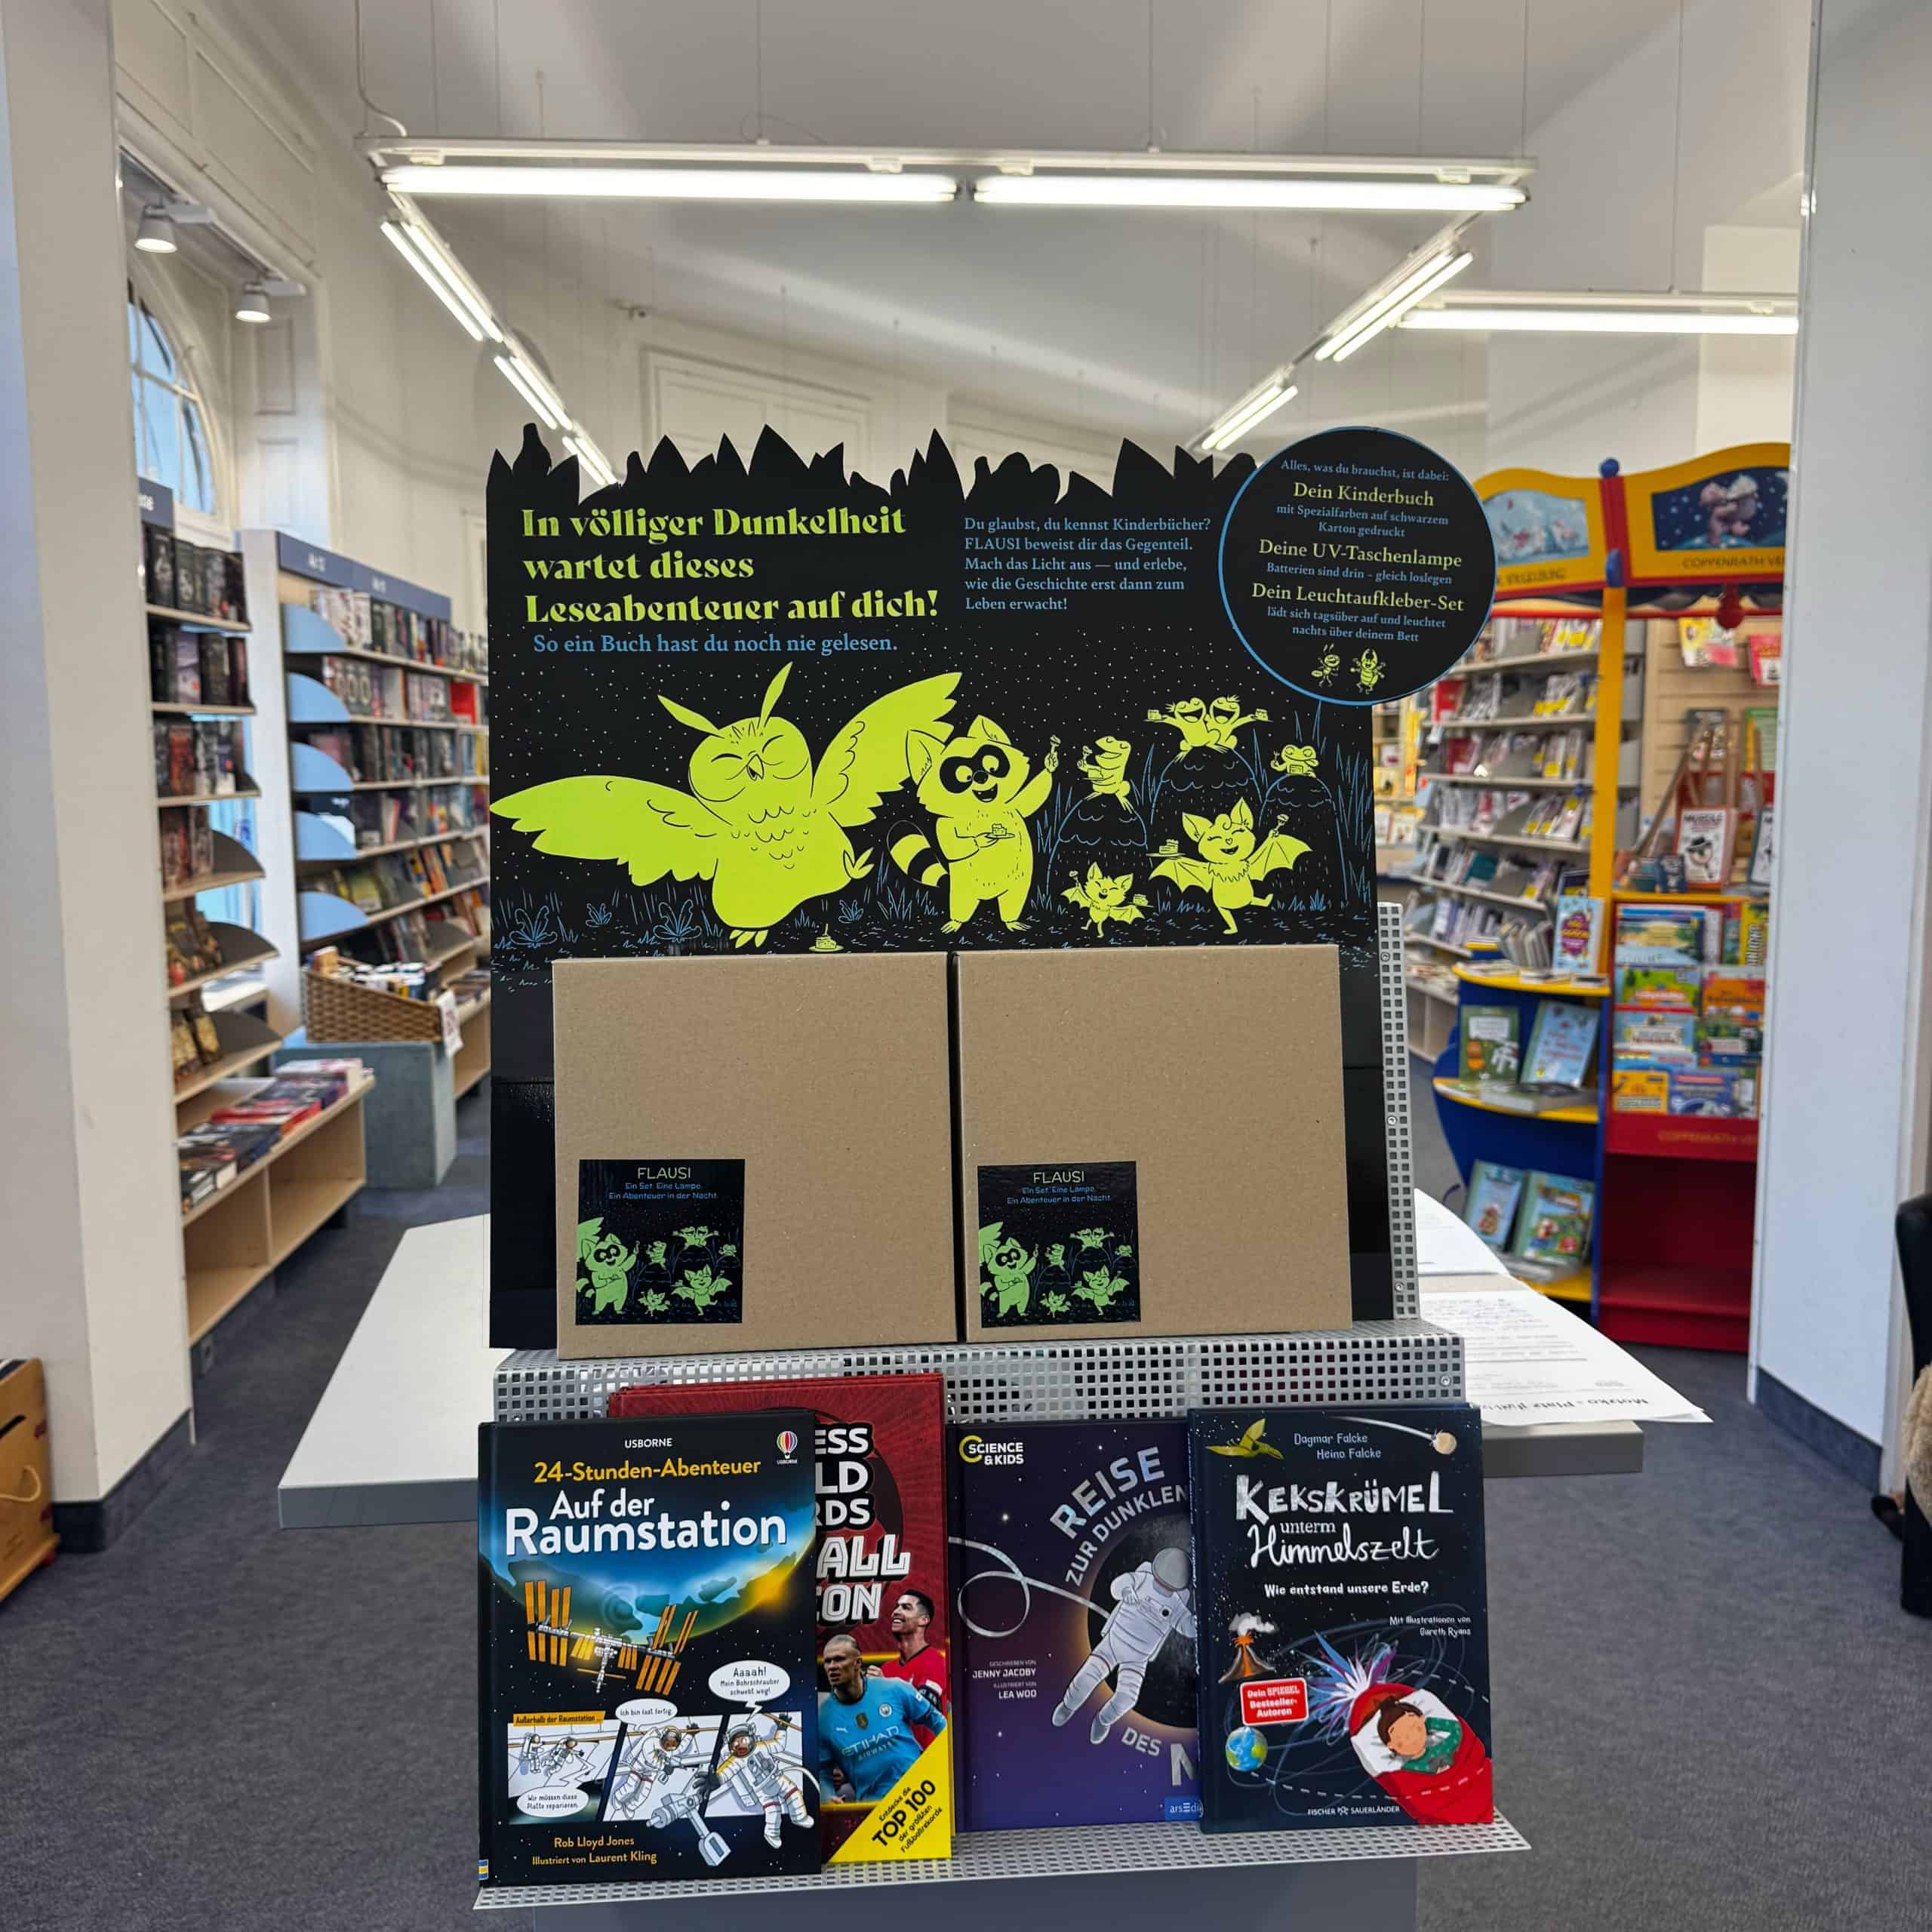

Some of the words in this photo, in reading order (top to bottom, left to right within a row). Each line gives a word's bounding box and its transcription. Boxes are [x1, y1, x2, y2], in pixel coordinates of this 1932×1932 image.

[1281, 460, 1311, 472] Alles,
[1314, 463, 1334, 473] was
[1336, 463, 1349, 474] du
[1352, 464, 1399, 478] brauchst,
[1402, 468, 1416, 478] ist
[1418, 469, 1449, 481] dabei:
[1294, 481, 1333, 500] Dein
[1338, 485, 1434, 506] Kinderbuch
[1276, 504, 1294, 515] mit
[1297, 505, 1369, 521] Spezialfarben
[1371, 510, 1389, 521] auf
[1390, 511, 1449, 525] schwarzem
[521, 509, 560, 537] In
[570, 508, 703, 544] völliger
[712, 506, 906, 536] Dunkelheit
[964, 518, 984, 530] Du
[988, 518, 1040, 533] glaubst,
[1044, 518, 1060, 530] du
[1064, 518, 1109, 531] kennst
[1112, 518, 1211, 531] Kinderbücher?
[1318, 521, 1356, 534] Karton
[1358, 525, 1405, 538] gedruckt
[965, 538, 1020, 550] FLAUSI
[1025, 538, 1075, 550] beweist
[1078, 538, 1097, 550] dir
[1100, 538, 1122, 550] das
[1125, 538, 1192, 553] Gegenteil.
[1259, 538, 1308, 557] Deine
[1312, 542, 1462, 571] UV-Taschenlampe
[522, 553, 641, 580] wartet
[650, 550, 754, 579] dieses
[965, 558, 1003, 571] Mach
[1006, 558, 1028, 571] das
[1032, 558, 1066, 571] Licht
[1069, 561, 1091, 571] aus
[1115, 558, 1140, 571] und
[1143, 558, 1187, 572] erlebe,
[1267, 562, 1315, 576] Batterien
[1318, 565, 1339, 577] sind
[1342, 565, 1364, 578] drin
[1376, 568, 1407, 582] gleich
[1409, 571, 1452, 586] loslegen
[965, 578, 988, 590] wie
[992, 577, 1012, 590] die
[1015, 577, 1088, 590] Geschichte
[1091, 580, 1115, 590] erst
[1119, 578, 1152, 590] dann
[1155, 581, 1185, 590] zum
[965, 598, 1007, 611] Leben
[1010, 598, 1068, 611] erwacht!
[1251, 583, 1291, 600] Dein
[1296, 586, 1464, 611] Leuchtaufkleber-Set
[525, 594, 778, 623] Leseabenteuer
[787, 591, 846, 619] auf
[851, 589, 938, 618] dich!
[1267, 606, 1287, 618] lädt
[1290, 608, 1311, 620] sich
[1312, 610, 1358, 624] tagsüber
[1361, 611, 1377, 623] auf
[1380, 614, 1401, 625] und
[1403, 616, 1447, 628] leuchtet
[1292, 625, 1327, 636] nachts
[1329, 627, 1352, 638] über
[1355, 628, 1394, 640] deinem
[1397, 631, 1419, 641] Bett
[534, 635, 558, 653] So
[564, 634, 595, 653] ein
[601, 635, 652, 653] Buch
[657, 633, 698, 653] hast
[704, 633, 729, 653] du
[734, 633, 780, 652] noch
[787, 634, 817, 652] nie
[821, 635, 897, 656] gelesen.
[638, 1167, 691, 1180] FLAUSI
[1033, 1171, 1084, 1184] FLAUSI
[624, 1438, 672, 1449] USBORNE
[1294, 1433, 1333, 1446] Dagmar
[1337, 1432, 1368, 1444] Falcke
[968, 1442, 1023, 1454] SCIENCE
[1317, 1448, 1345, 1460] Heino
[1349, 1448, 1381, 1460] Falcke
[984, 1456, 993, 1466] &
[995, 1454, 1024, 1466] KIDS
[534, 1458, 761, 1484] 24-Stunden-Abenteuer
[1050, 1446, 1165, 1540] REISE
[1235, 1470, 1454, 1525] KEKSKRÜMEL
[549, 1488, 605, 1521] Auf
[610, 1487, 655, 1517] der
[506, 1500, 787, 1556] Raumstation
[1280, 1522, 1336, 1534] unterm
[1247, 1522, 1440, 1568] Himmelszelt
[1066, 1540, 1097, 1586] ZUR
[1264, 1583, 1286, 1598] Wie
[1290, 1583, 1343, 1595] entstand
[1347, 1584, 1388, 1595] unsere
[1392, 1580, 1429, 1595] Erde?
[816, 1583, 881, 1621] ON
[1389, 1616, 1404, 1626] Mit
[1405, 1616, 1455, 1624] Illustrationen
[972, 1669, 1001, 1678] JENNY
[1003, 1668, 1036, 1677] JACOBY
[998, 1690, 1014, 1700] LEA
[1016, 1689, 1037, 1699] WOO
[1247, 1689, 1266, 1698] Dein
[1249, 1697, 1297, 1709] Bestseller-
[1257, 1709, 1292, 1718] Autoren
[1121, 1727, 1162, 1757] DES
[872, 1809, 907, 1847] TOP
[906, 1780, 936, 1810] 100
[1308, 1807, 1335, 1816] FISCHER
[1351, 1805, 1400, 1814] SAUERLÄNDER
[554, 1837, 575, 1848] Rob
[577, 1835, 605, 1850] Lloyd
[606, 1835, 635, 1847] Jones
[532, 1855, 569, 1866] Illustriert
[589, 1853, 628, 1863] Laurent
[629, 1850, 657, 1865] Kling
